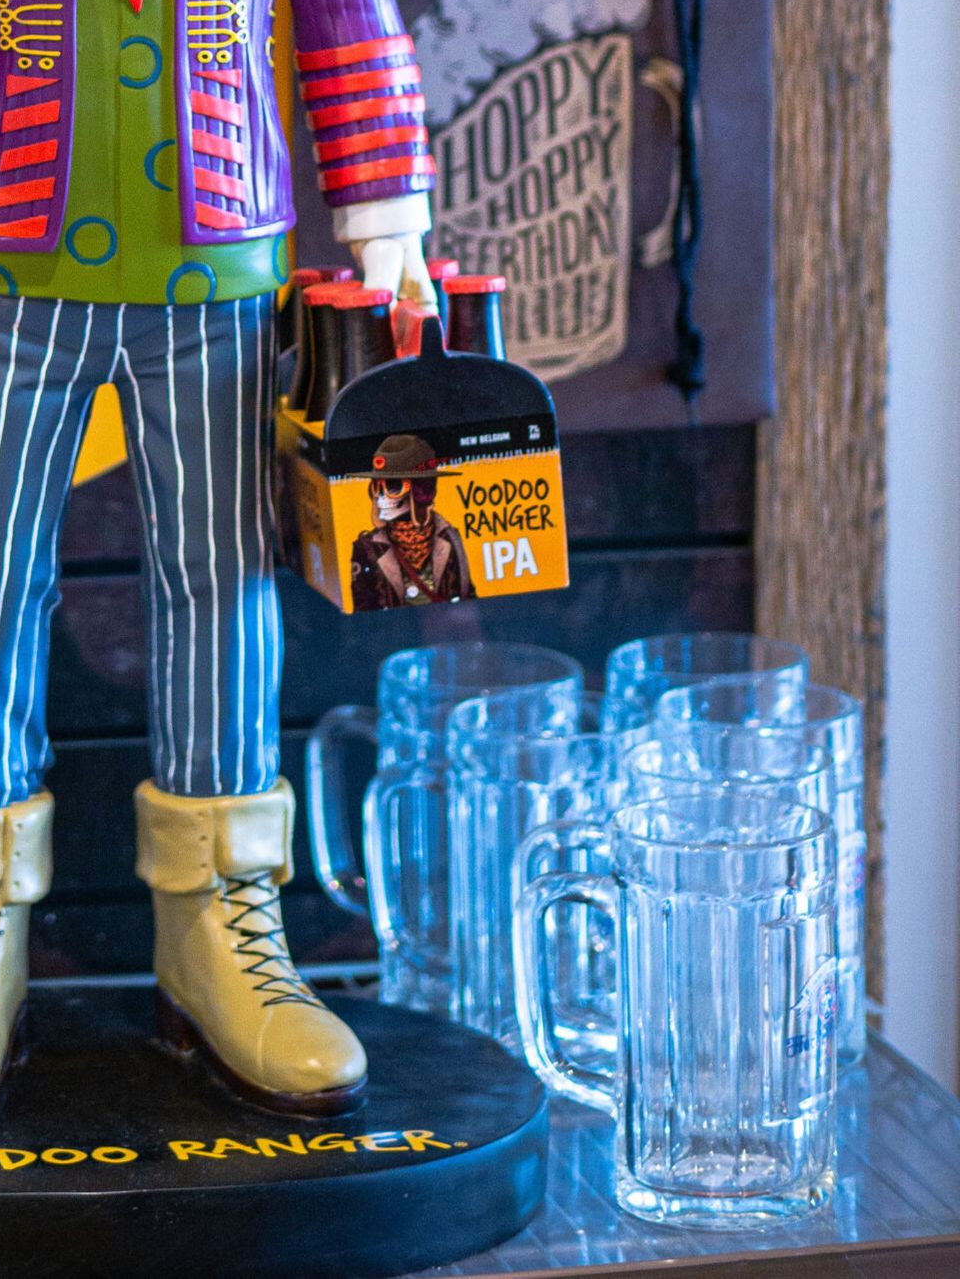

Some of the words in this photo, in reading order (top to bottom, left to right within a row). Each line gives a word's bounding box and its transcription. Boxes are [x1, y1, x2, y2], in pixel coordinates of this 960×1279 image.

[487, 122, 620, 228] HOPPY
[456, 478, 549, 510] VOODOO
[463, 504, 555, 539] RANGER
[482, 537, 539, 582] IPA
